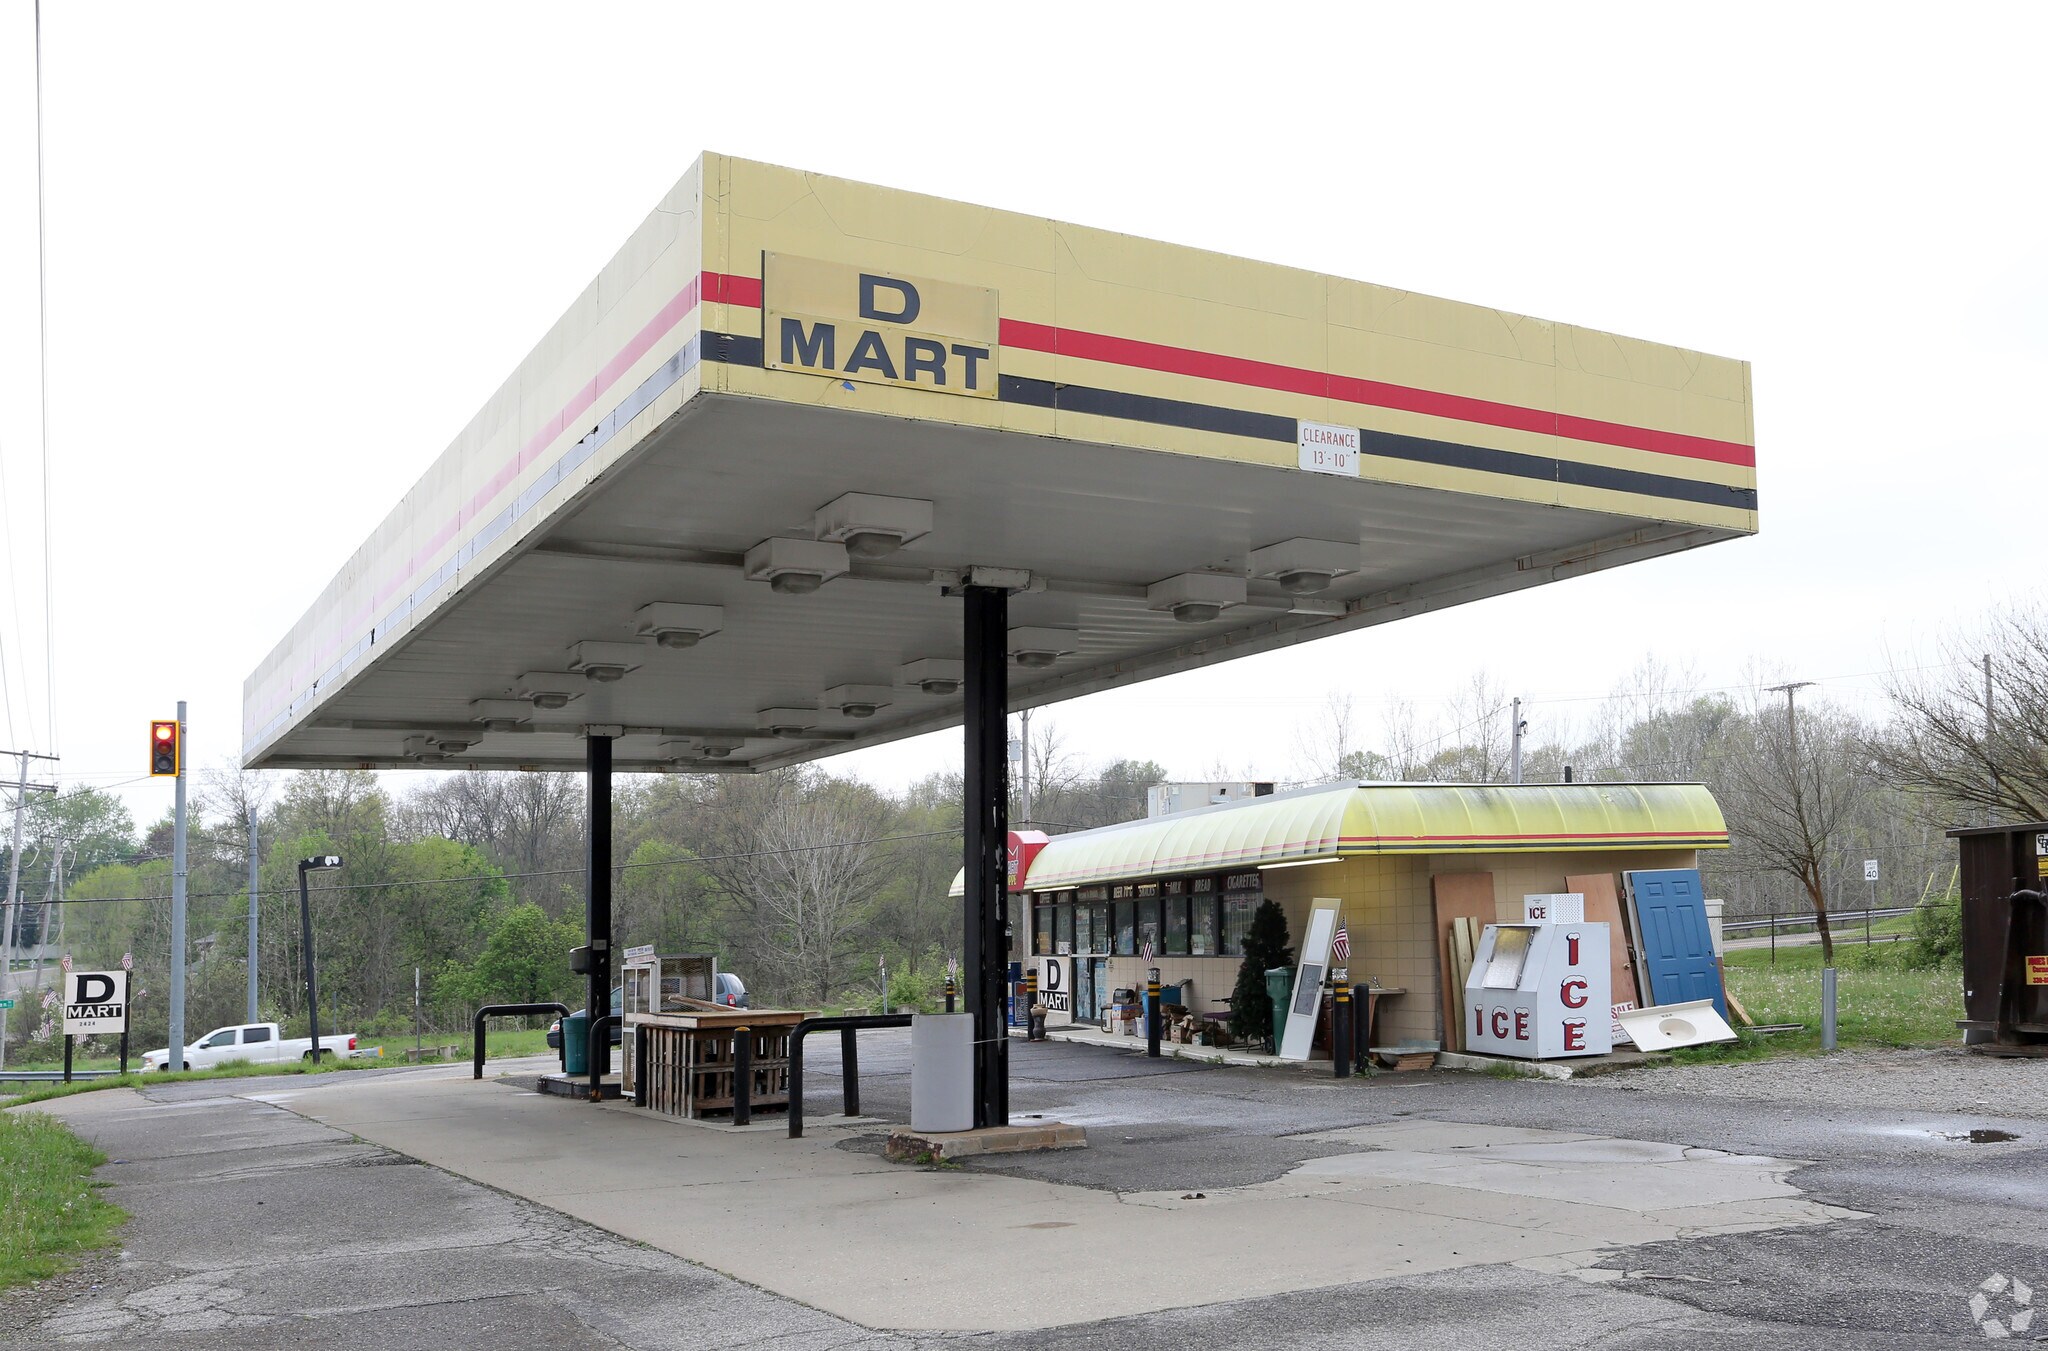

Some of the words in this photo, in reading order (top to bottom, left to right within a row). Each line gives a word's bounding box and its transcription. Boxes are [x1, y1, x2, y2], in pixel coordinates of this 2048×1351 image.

[858, 273, 920, 325] D
[780, 317, 990, 390] MART
[1303, 428, 1356, 448] CLEARANCE
[1227, 873, 1260, 889] CIGARETTES
[1866, 870, 1877, 878] 40
[1194, 879, 1211, 892] BREAD
[1529, 905, 1547, 919] ICE
[1046, 959, 1062, 991] D
[74, 973, 116, 1004] D
[1560, 932, 1588, 1051] ICE
[1040, 992, 1067, 1010] MART
[67, 1005, 121, 1018] MART
[1474, 1003, 1531, 1041] ICE
